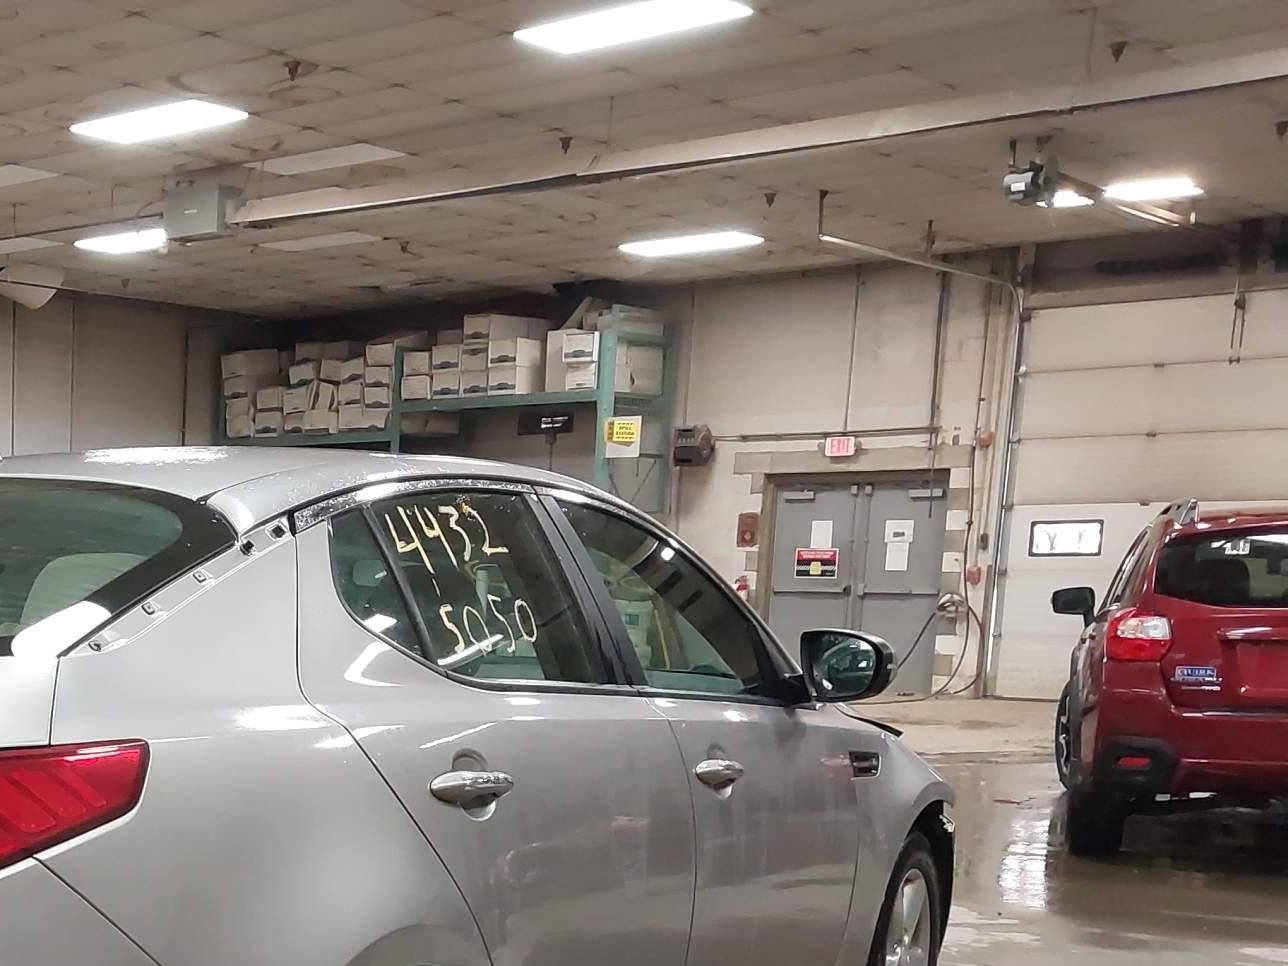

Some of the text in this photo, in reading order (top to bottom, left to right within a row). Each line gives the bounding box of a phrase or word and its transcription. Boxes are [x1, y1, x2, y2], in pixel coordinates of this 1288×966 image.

[829, 438, 851, 453] EXIT
[385, 503, 509, 574] 4432
[439, 594, 537, 655] 5050
